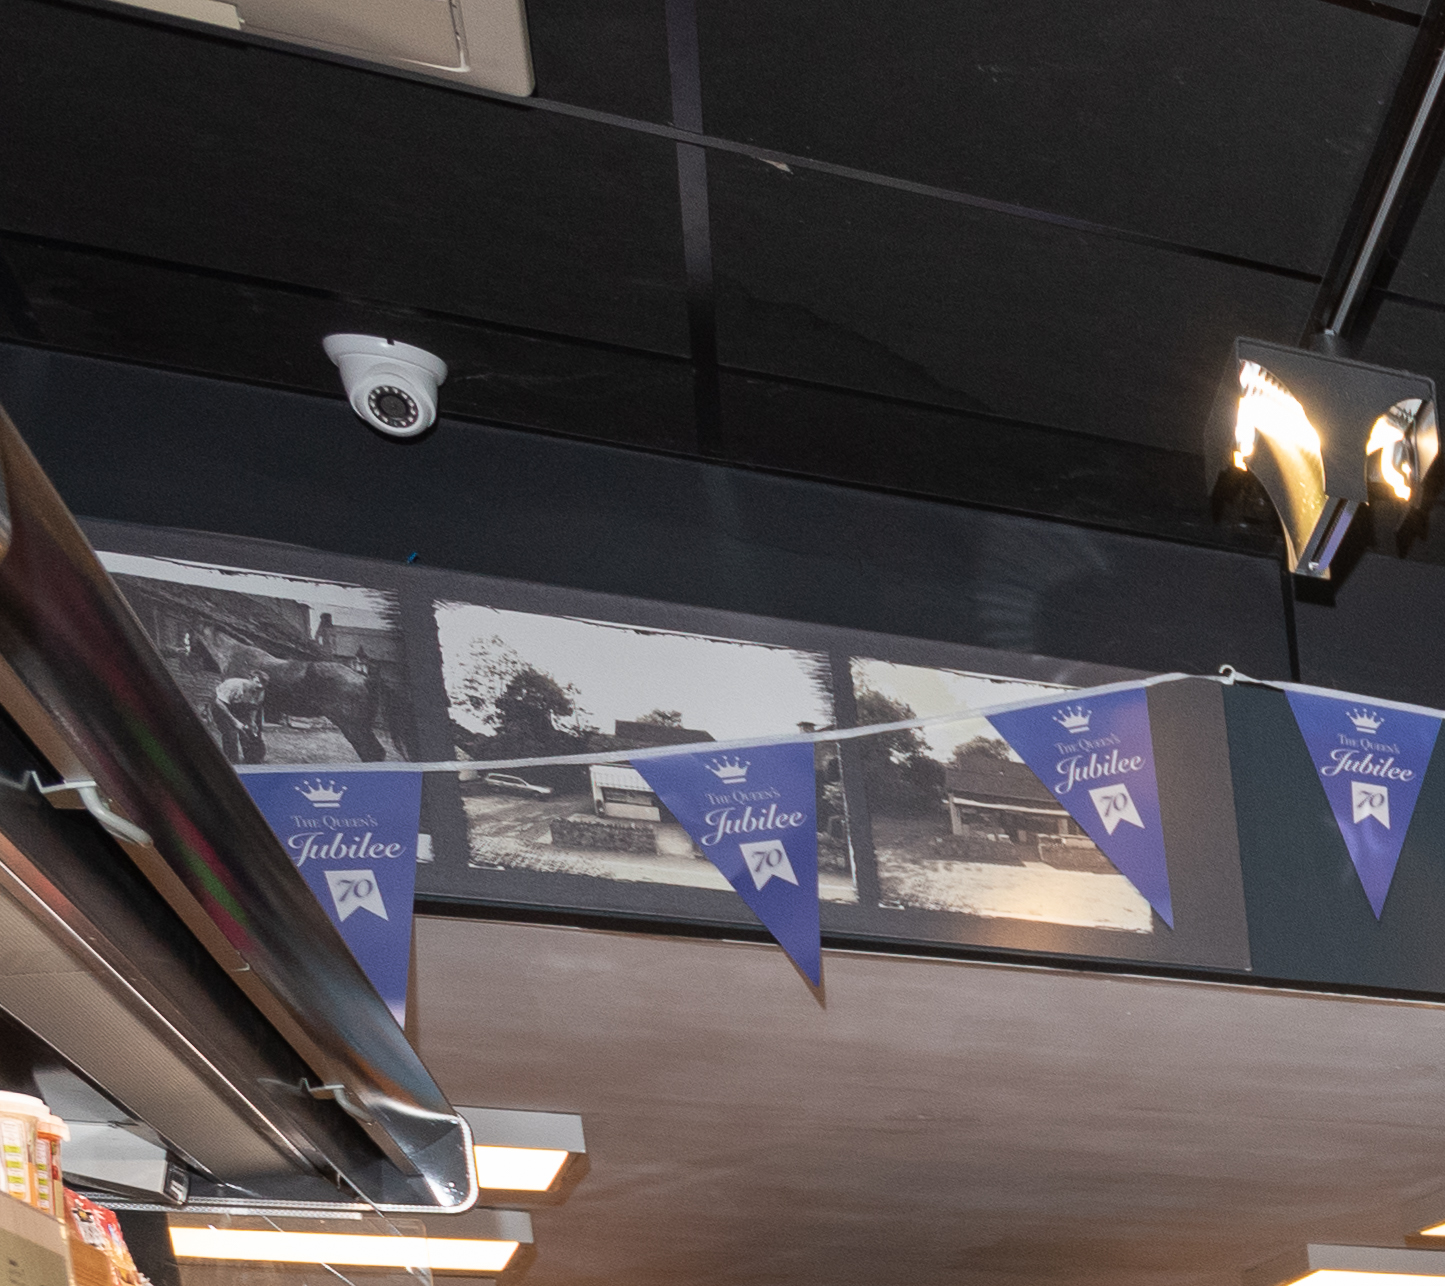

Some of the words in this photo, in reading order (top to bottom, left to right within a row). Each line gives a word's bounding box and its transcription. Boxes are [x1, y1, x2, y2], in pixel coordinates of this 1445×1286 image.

[701, 803, 808, 847] Jubilee
[287, 831, 407, 868] Jubilee
[751, 848, 783, 874] 70
[337, 878, 374, 903] 70
